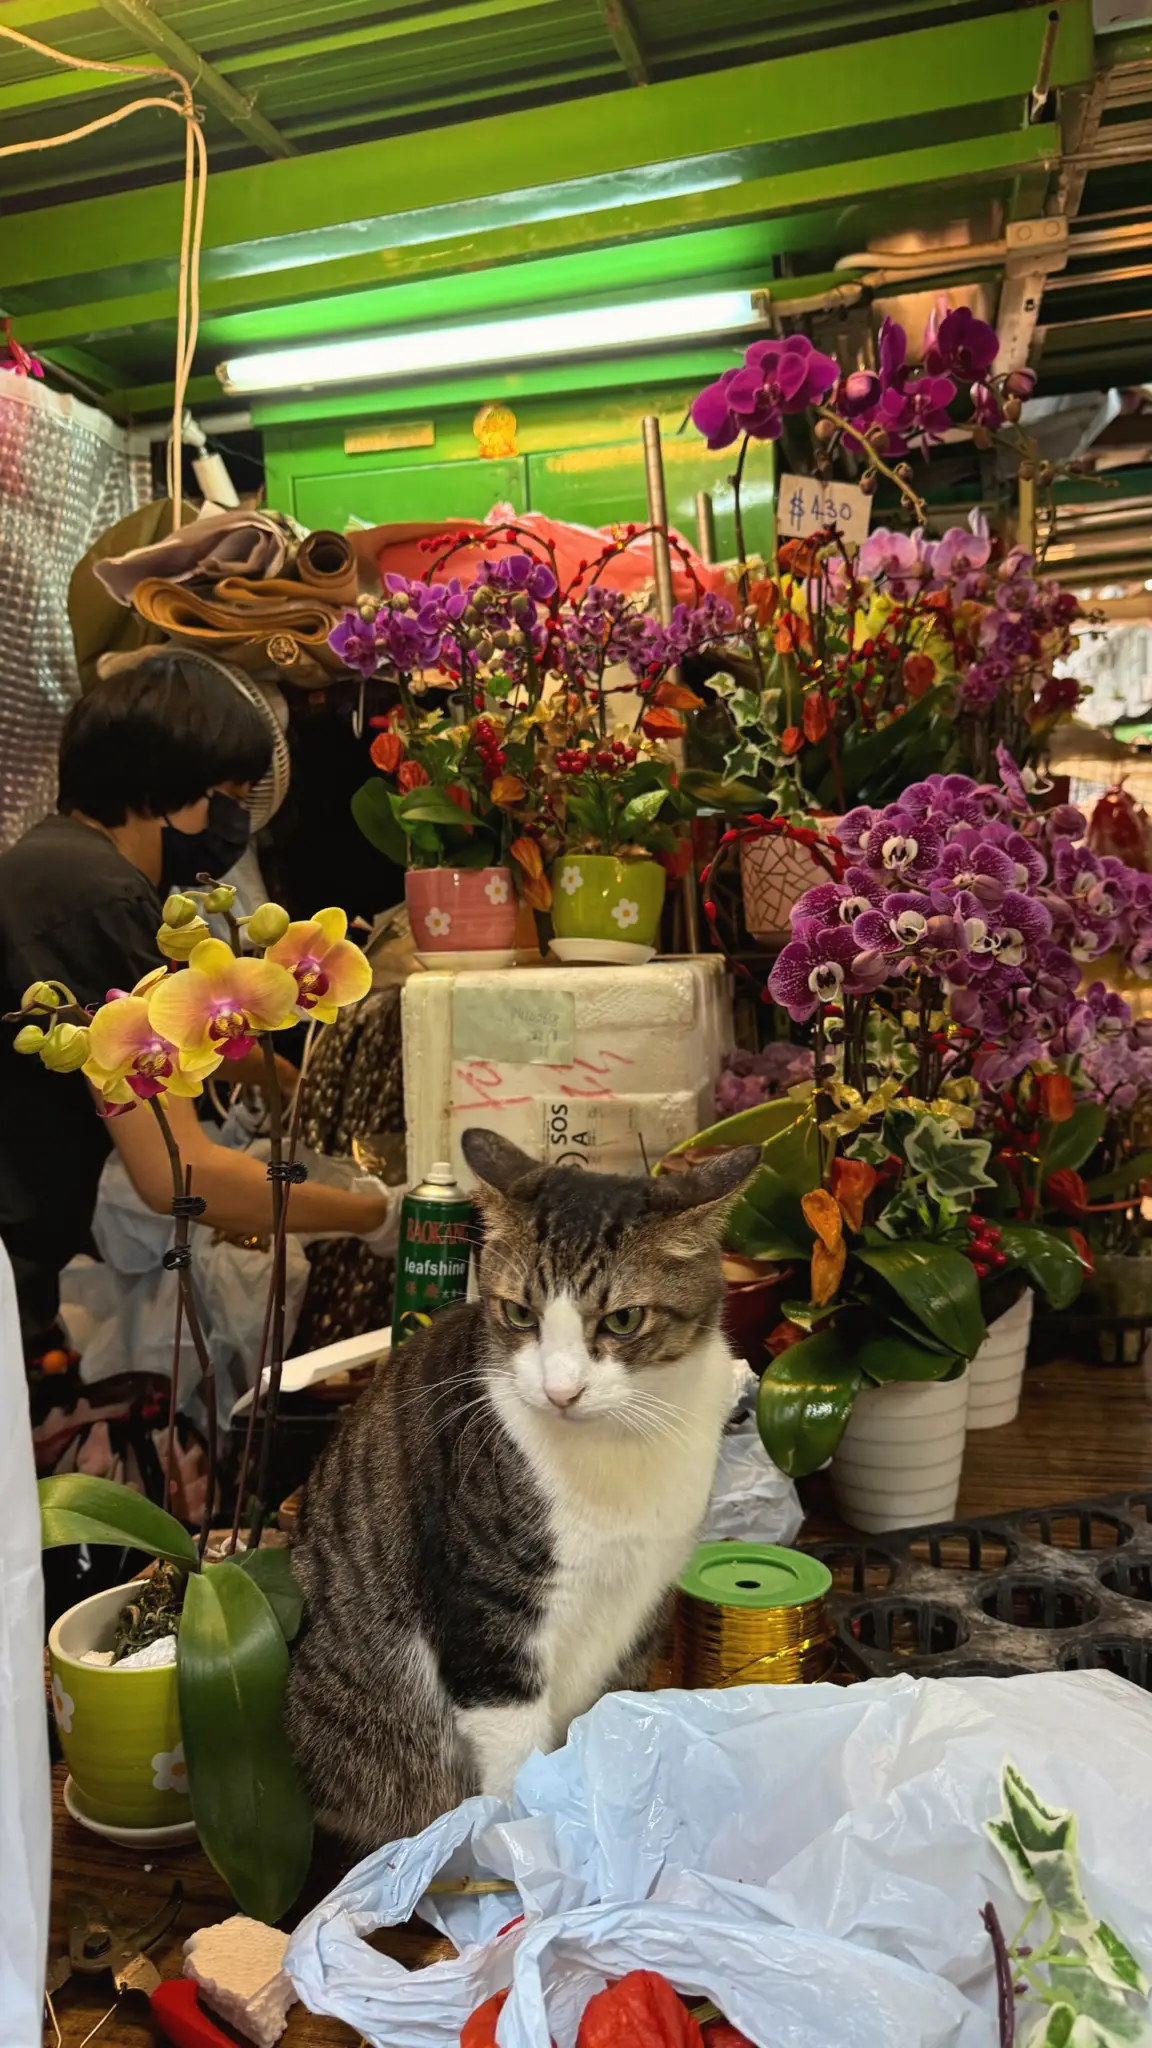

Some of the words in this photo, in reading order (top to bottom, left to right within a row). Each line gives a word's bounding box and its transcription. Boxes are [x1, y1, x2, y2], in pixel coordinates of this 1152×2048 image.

[551, 1104, 568, 1146] SOS
[571, 1131, 588, 1146] A
[404, 1256, 466, 1277] leafshine
